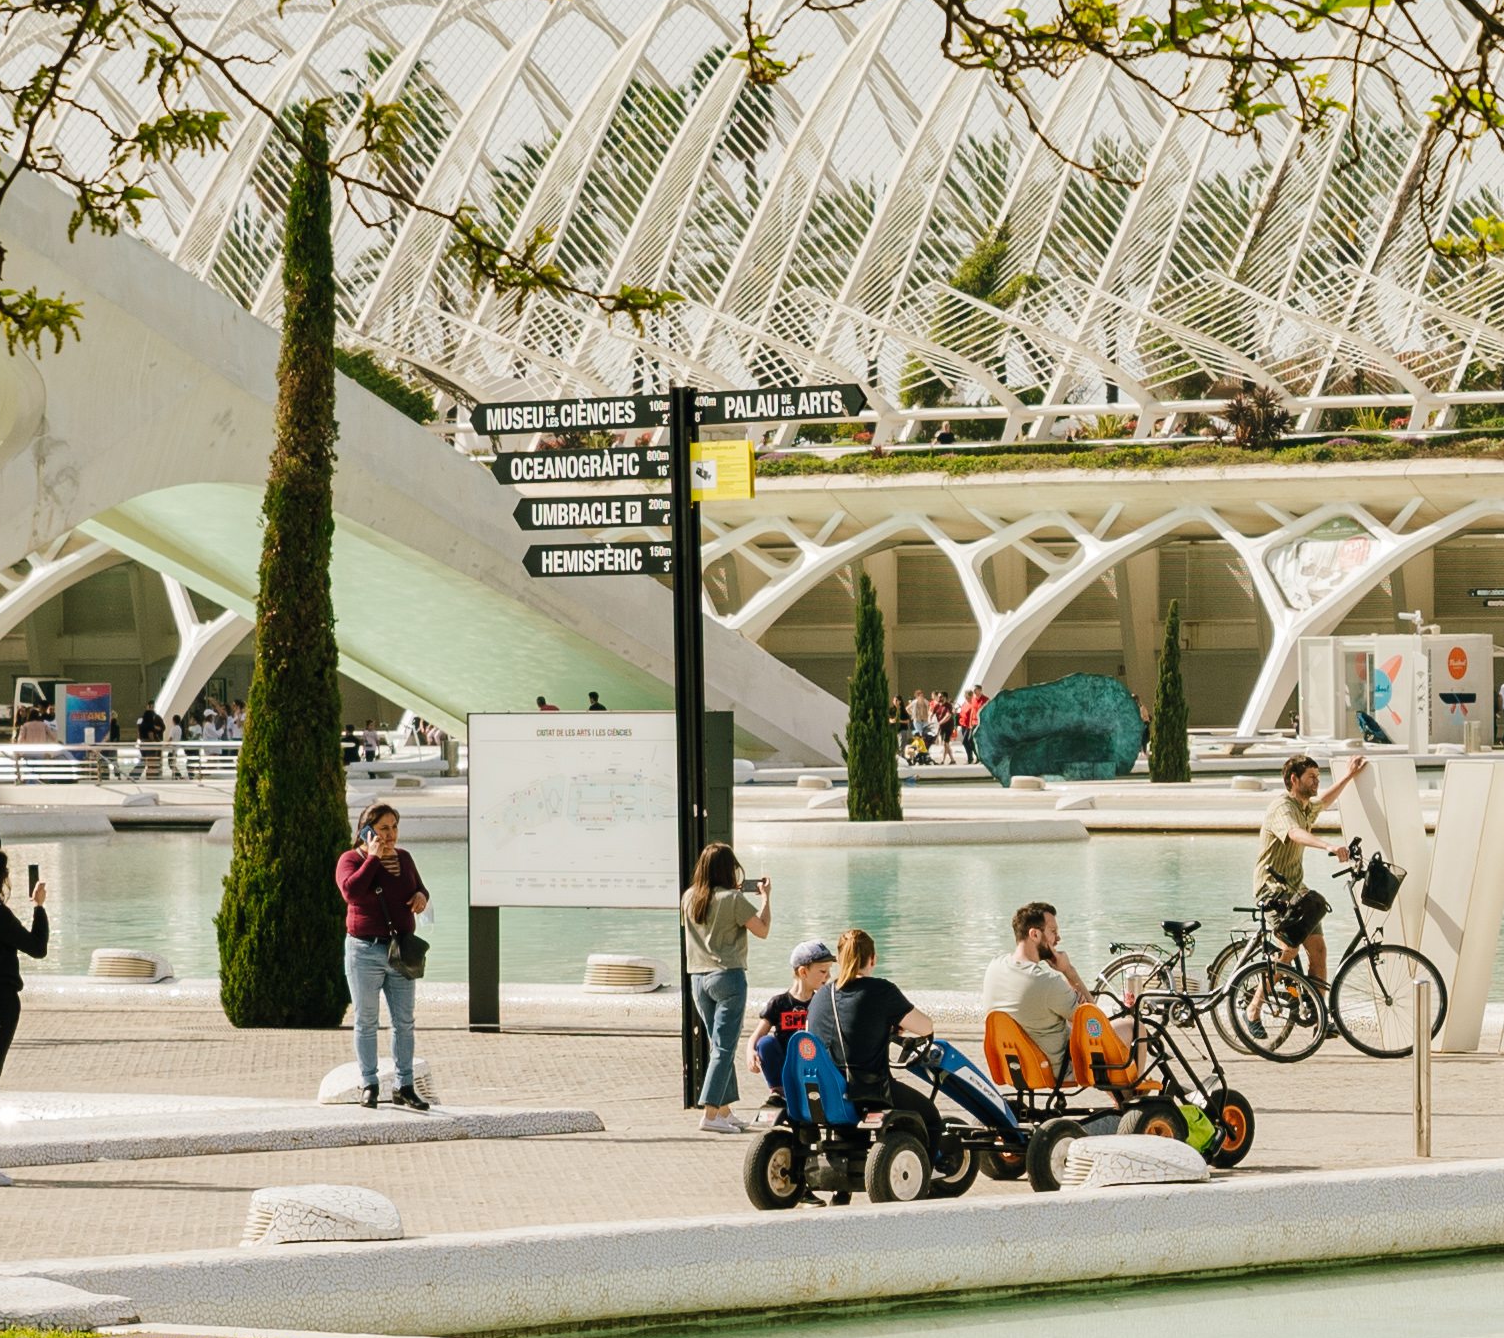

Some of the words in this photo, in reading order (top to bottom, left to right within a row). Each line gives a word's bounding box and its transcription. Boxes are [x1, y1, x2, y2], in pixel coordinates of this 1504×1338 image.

[781, 393, 792, 405] DE
[797, 391, 842, 415] ARTS
[546, 405, 556, 416] DE
[724, 394, 779, 419] PALAU
[781, 405, 796, 417] LES
[486, 406, 543, 431] MUSEU
[560, 399, 636, 427] CIÈNCIES
[546, 417, 560, 428] LES
[646, 451, 670, 461] 800m
[510, 449, 640, 481] OCEANOGRÀFIC
[648, 499, 671, 510] 200m
[532, 501, 622, 526] UMBRACLE
[649, 546, 672, 557] 150m
[542, 543, 642, 573] HEMISFÈRIC
[536, 729, 555, 737] CIUTAT
[556, 729, 563, 737] DE
[565, 729, 575, 737] LES
[577, 729, 591, 737] ARTS
[595, 729, 606, 737] LES
